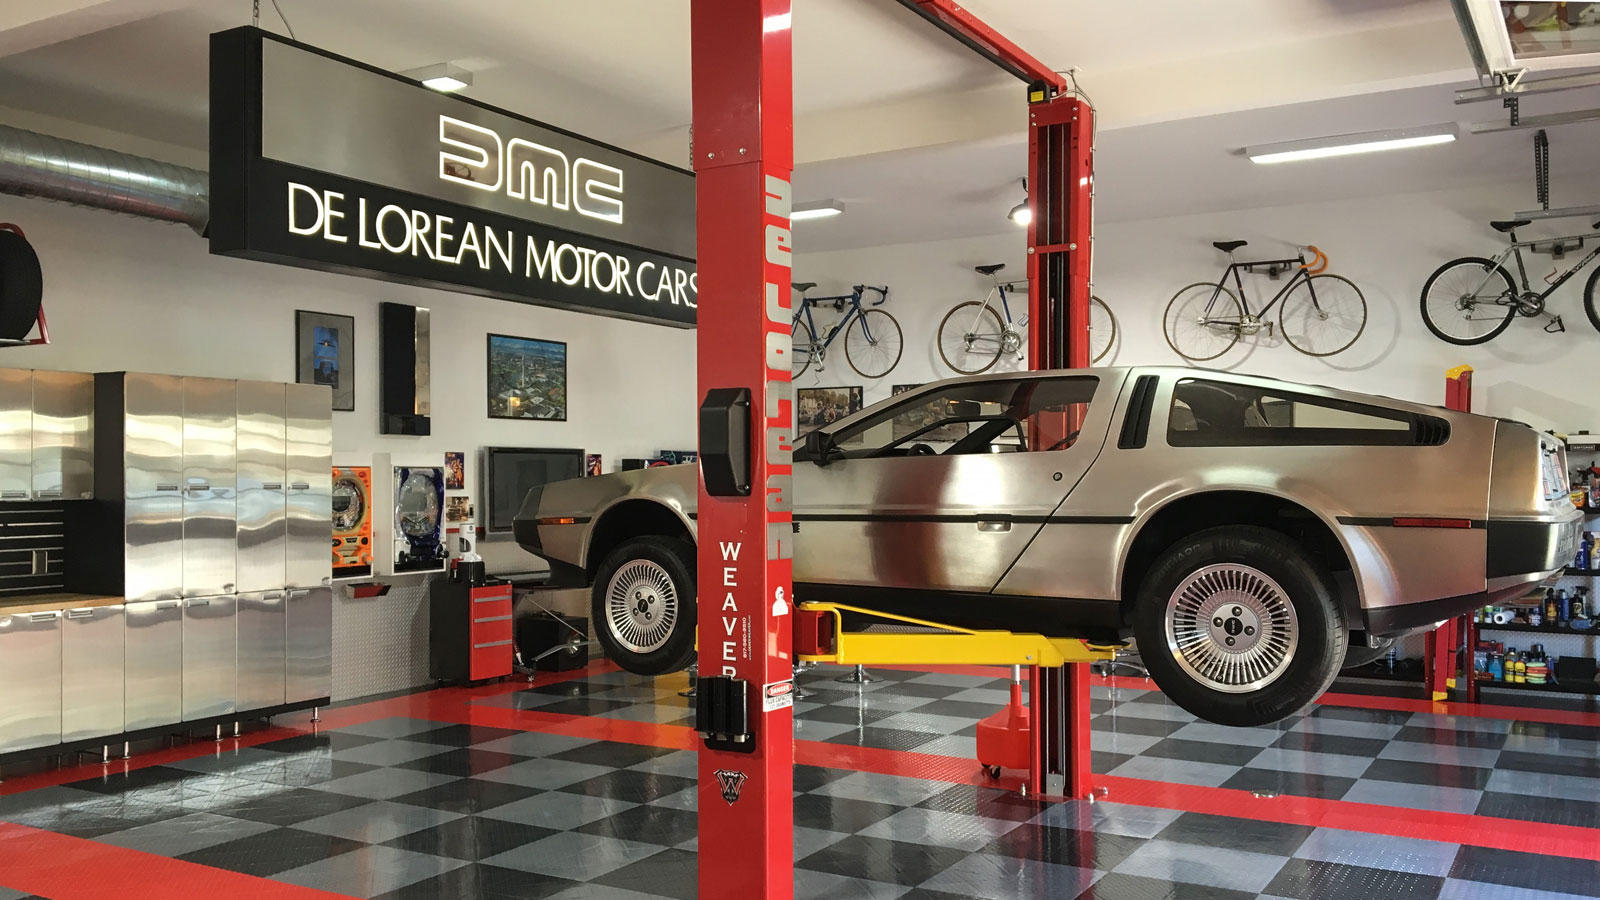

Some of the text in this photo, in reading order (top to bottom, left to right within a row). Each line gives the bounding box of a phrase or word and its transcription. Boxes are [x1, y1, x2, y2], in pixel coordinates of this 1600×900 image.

[287, 181, 348, 244] DE
[358, 197, 514, 275] LOREAN
[525, 234, 634, 297] MOTOR
